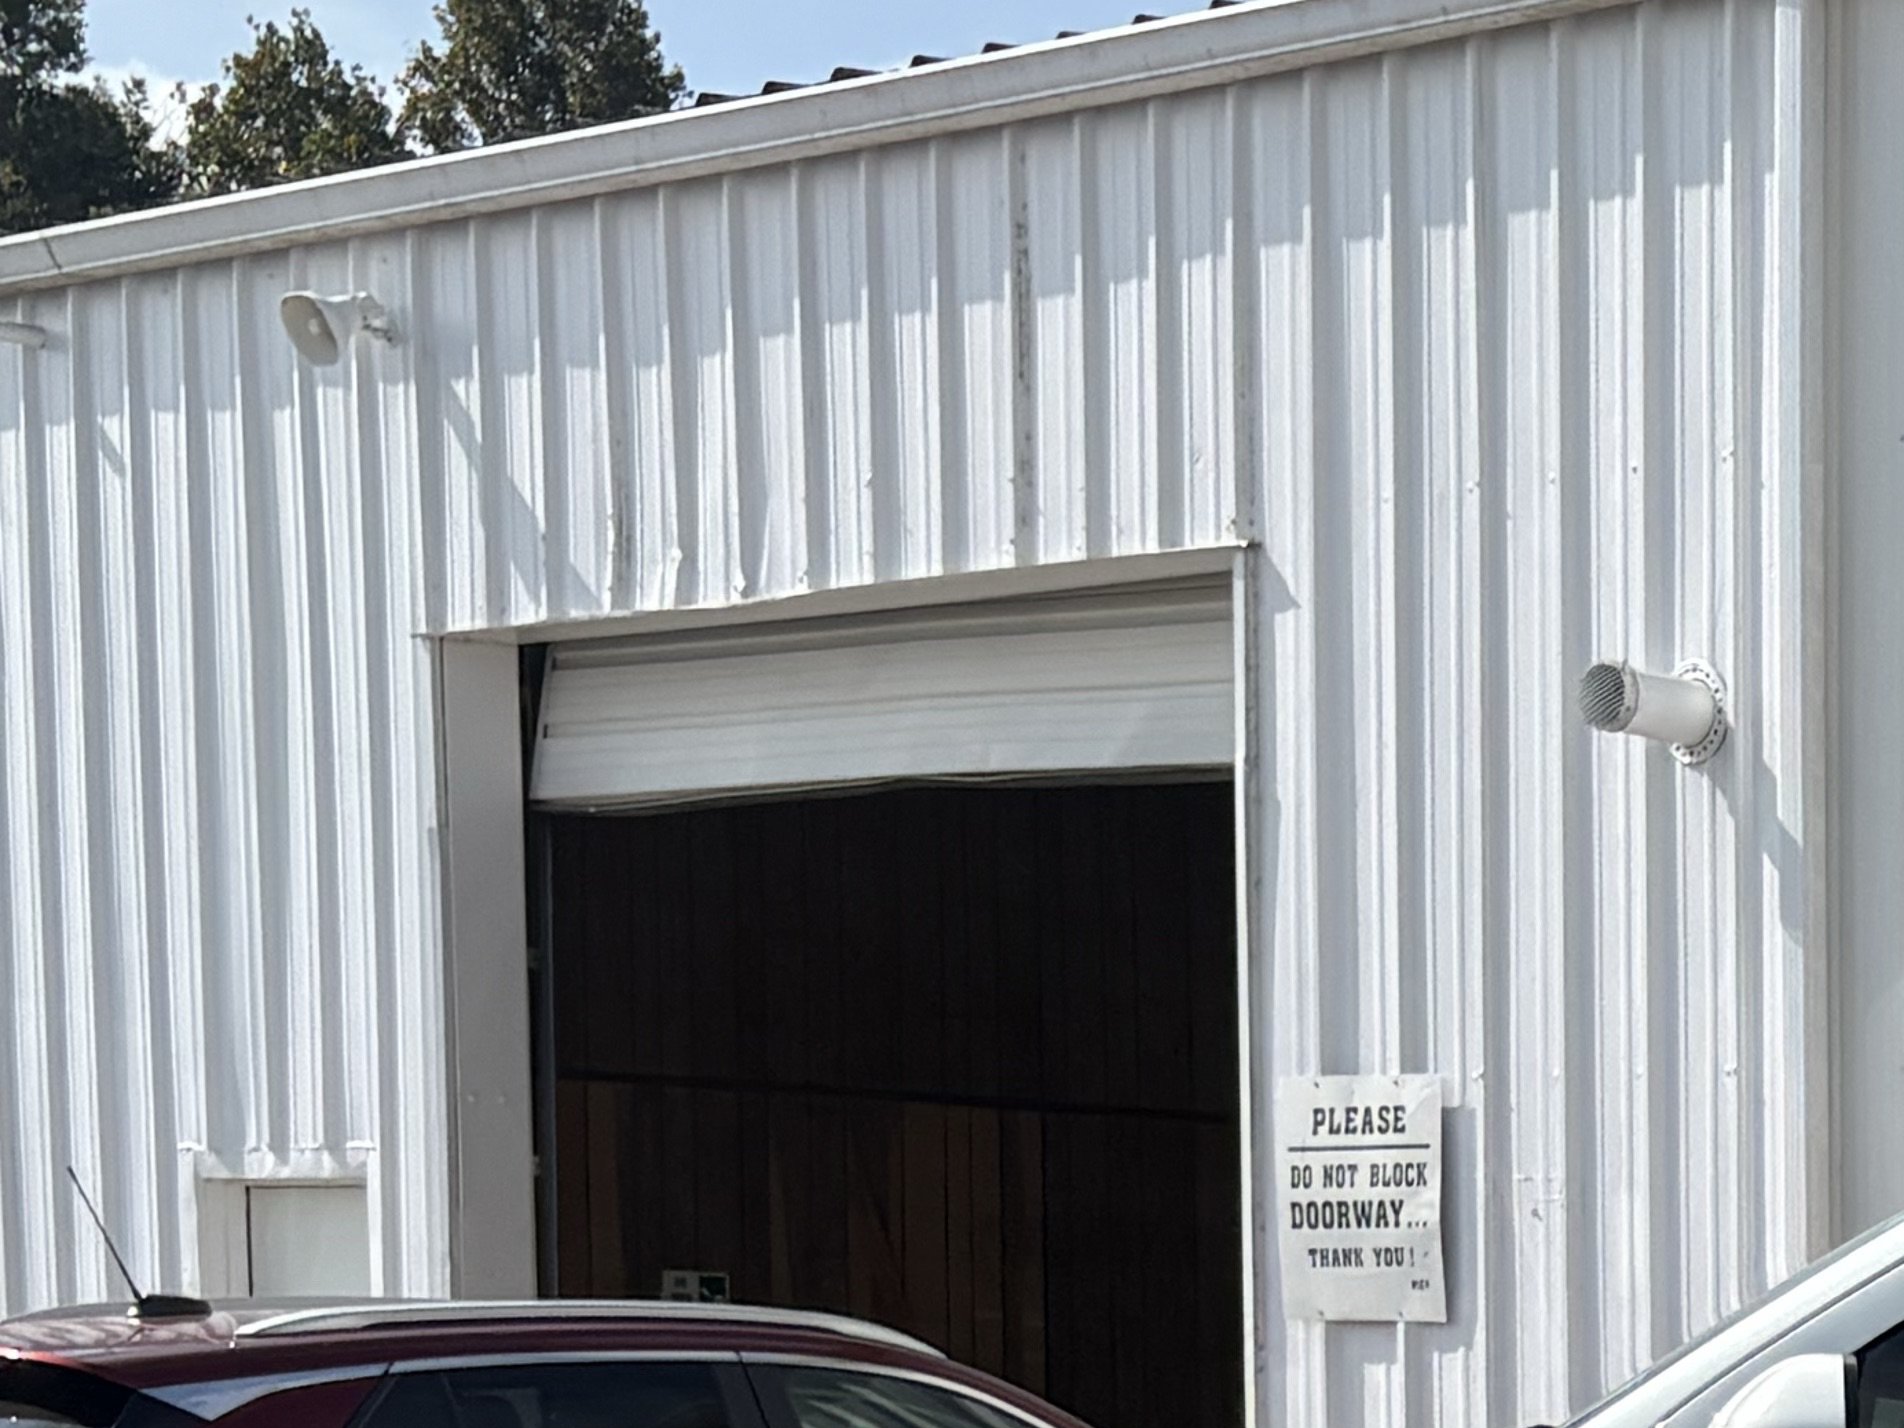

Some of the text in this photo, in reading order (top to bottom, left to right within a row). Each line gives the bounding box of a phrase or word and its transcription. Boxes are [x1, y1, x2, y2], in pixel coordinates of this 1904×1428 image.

[1312, 1106, 1406, 1136] PLEASE
[1290, 1162, 1427, 1189] DO NOT BLOCK
[1290, 1199, 1428, 1230] DOORWAY...
[1308, 1246, 1415, 1268] THANK YOU!
